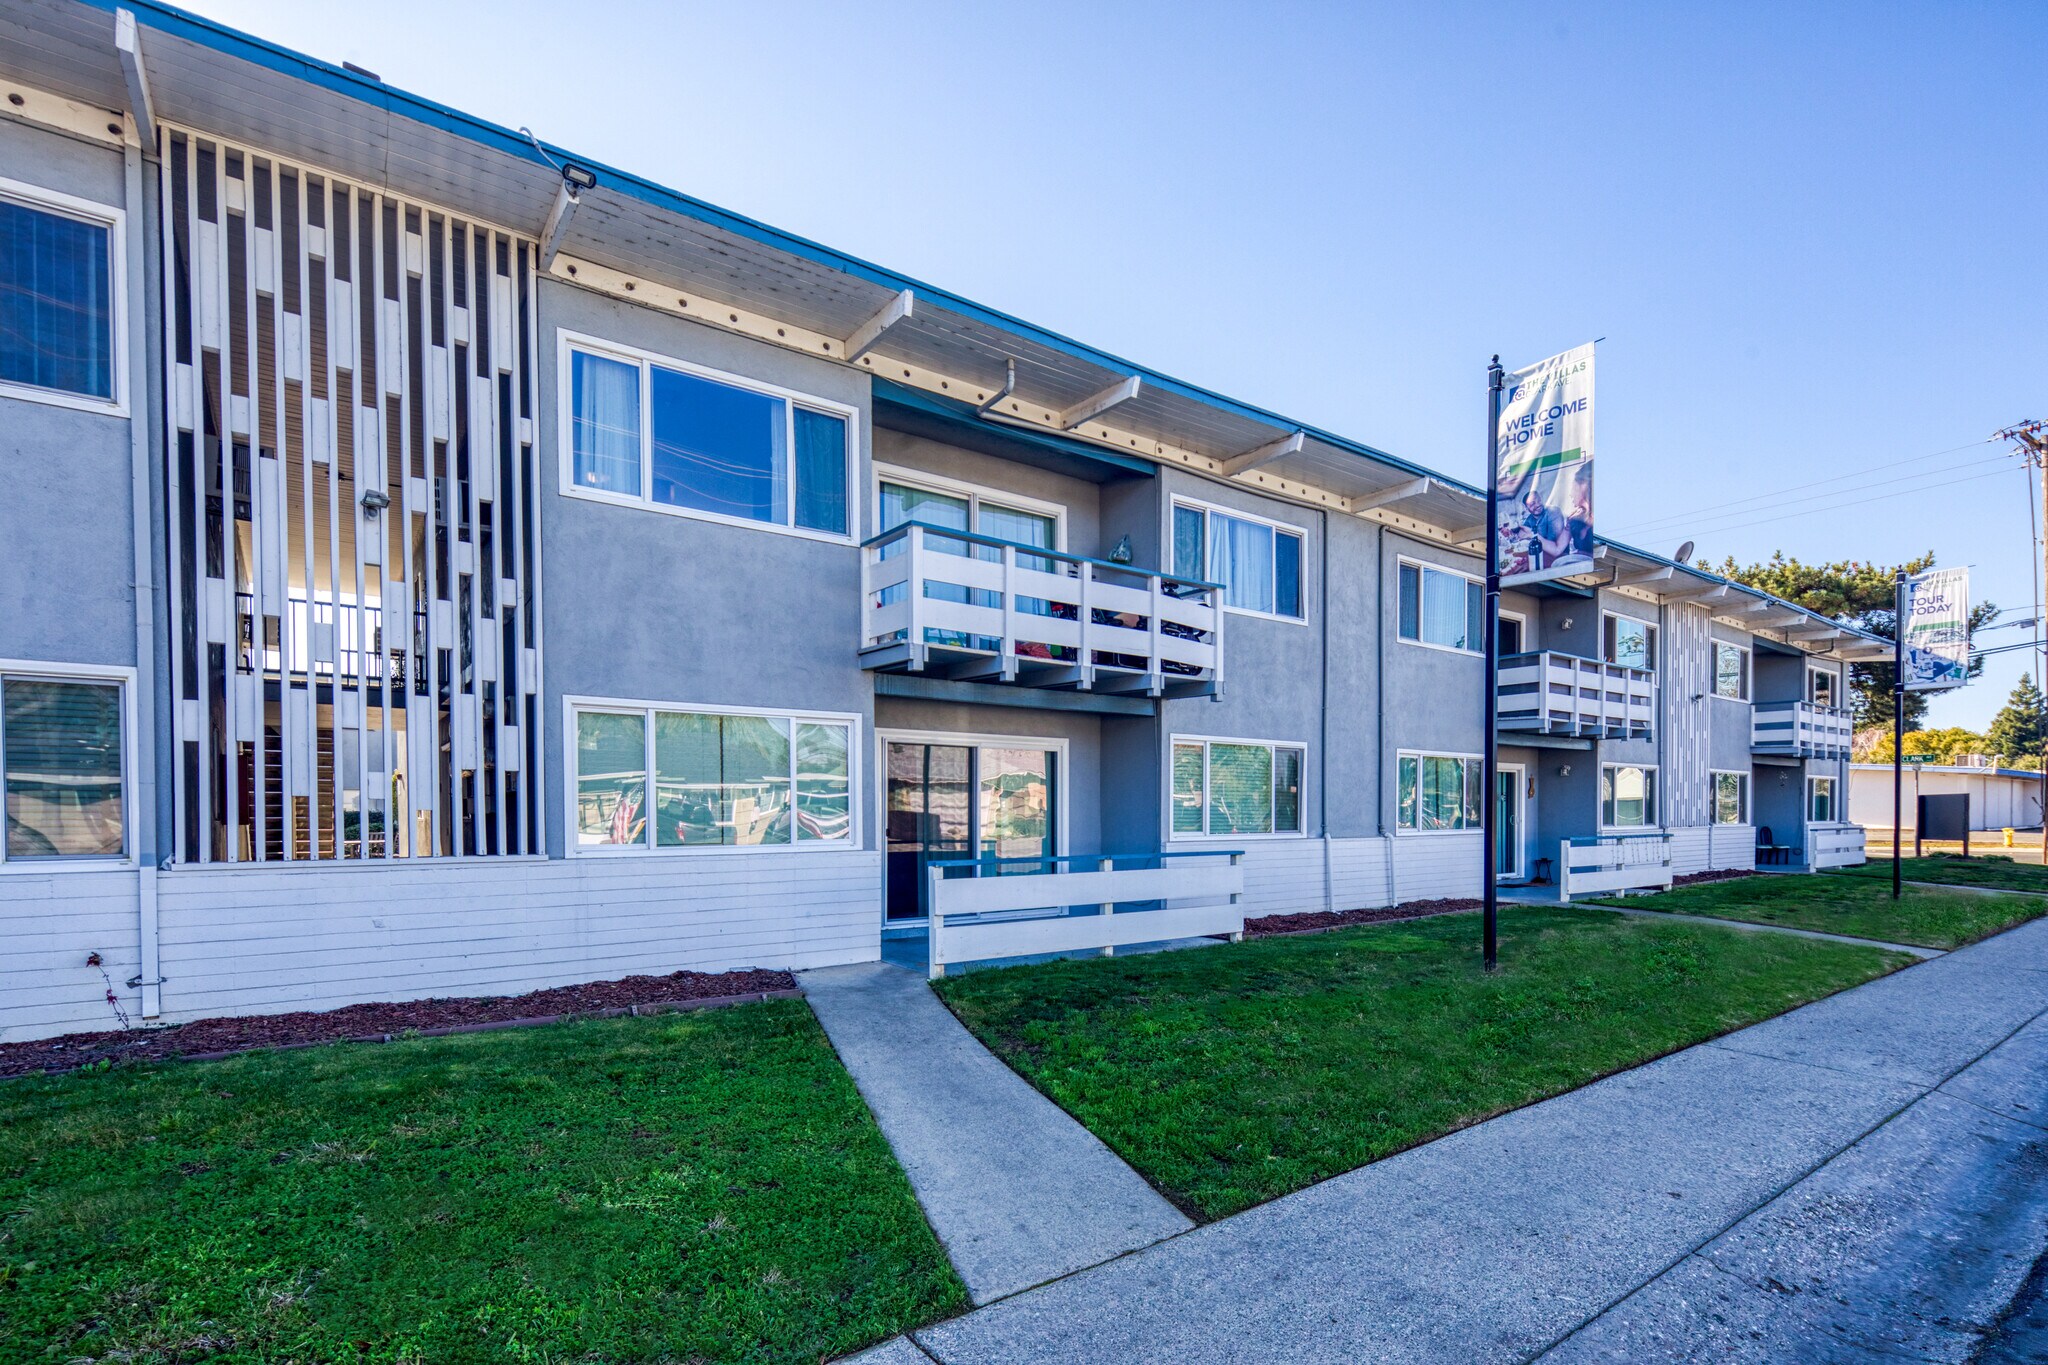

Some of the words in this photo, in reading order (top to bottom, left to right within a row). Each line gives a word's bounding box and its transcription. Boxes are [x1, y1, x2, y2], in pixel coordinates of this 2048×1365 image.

[1525, 385, 1553, 399] CARK
[1506, 397, 1587, 432] WELCOME
[1506, 422, 1554, 448] HOME
[1909, 595, 1944, 607] TOUR
[1909, 603, 1952, 616] TODAY
